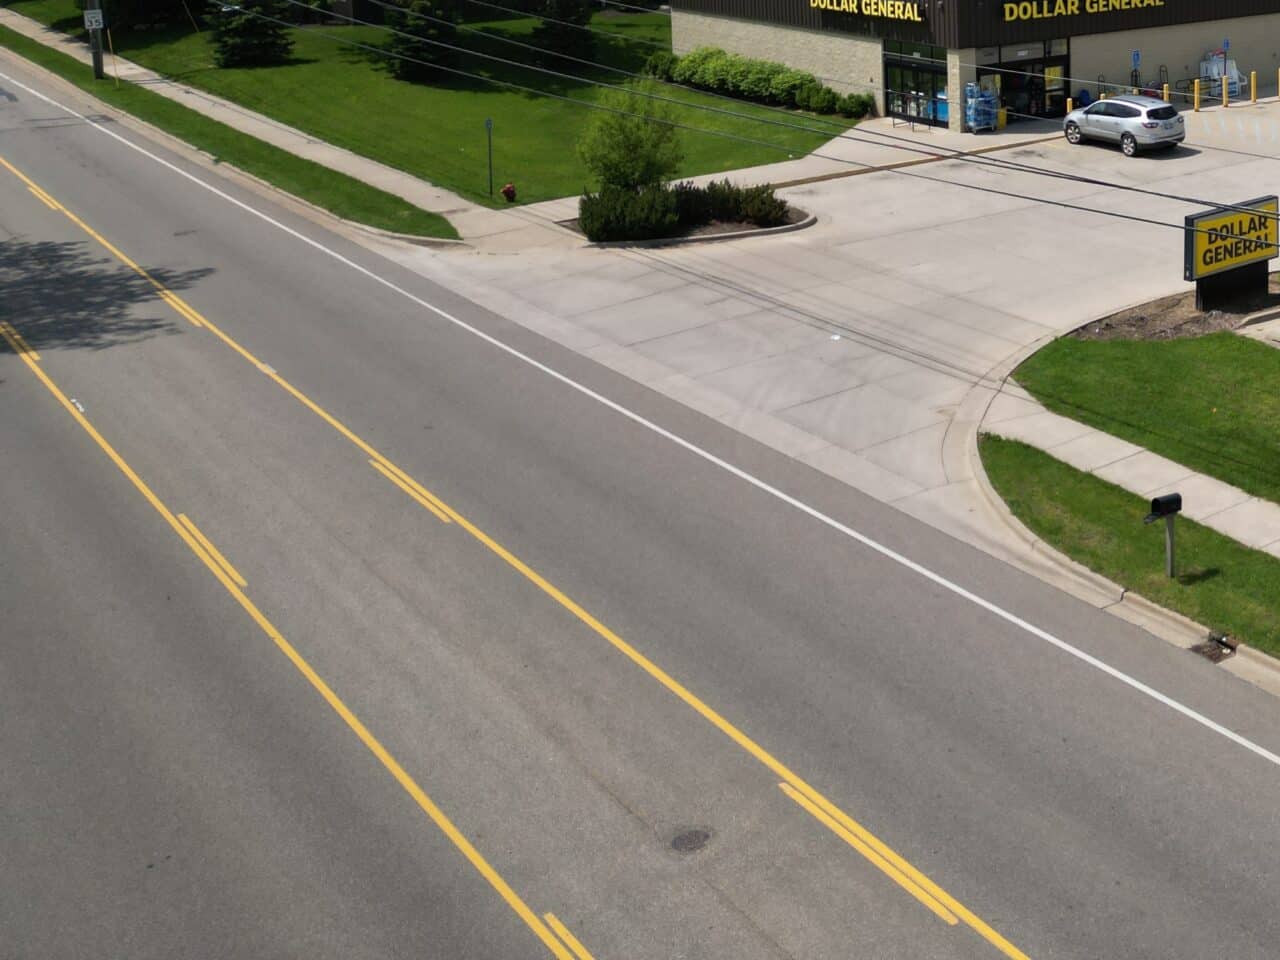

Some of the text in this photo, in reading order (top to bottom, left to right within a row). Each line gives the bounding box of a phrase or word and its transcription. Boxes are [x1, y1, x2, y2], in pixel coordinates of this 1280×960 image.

[87, 19, 102, 27] 35
[1207, 216, 1269, 245] DOLLAR
[1202, 232, 1273, 266] GENERAL
